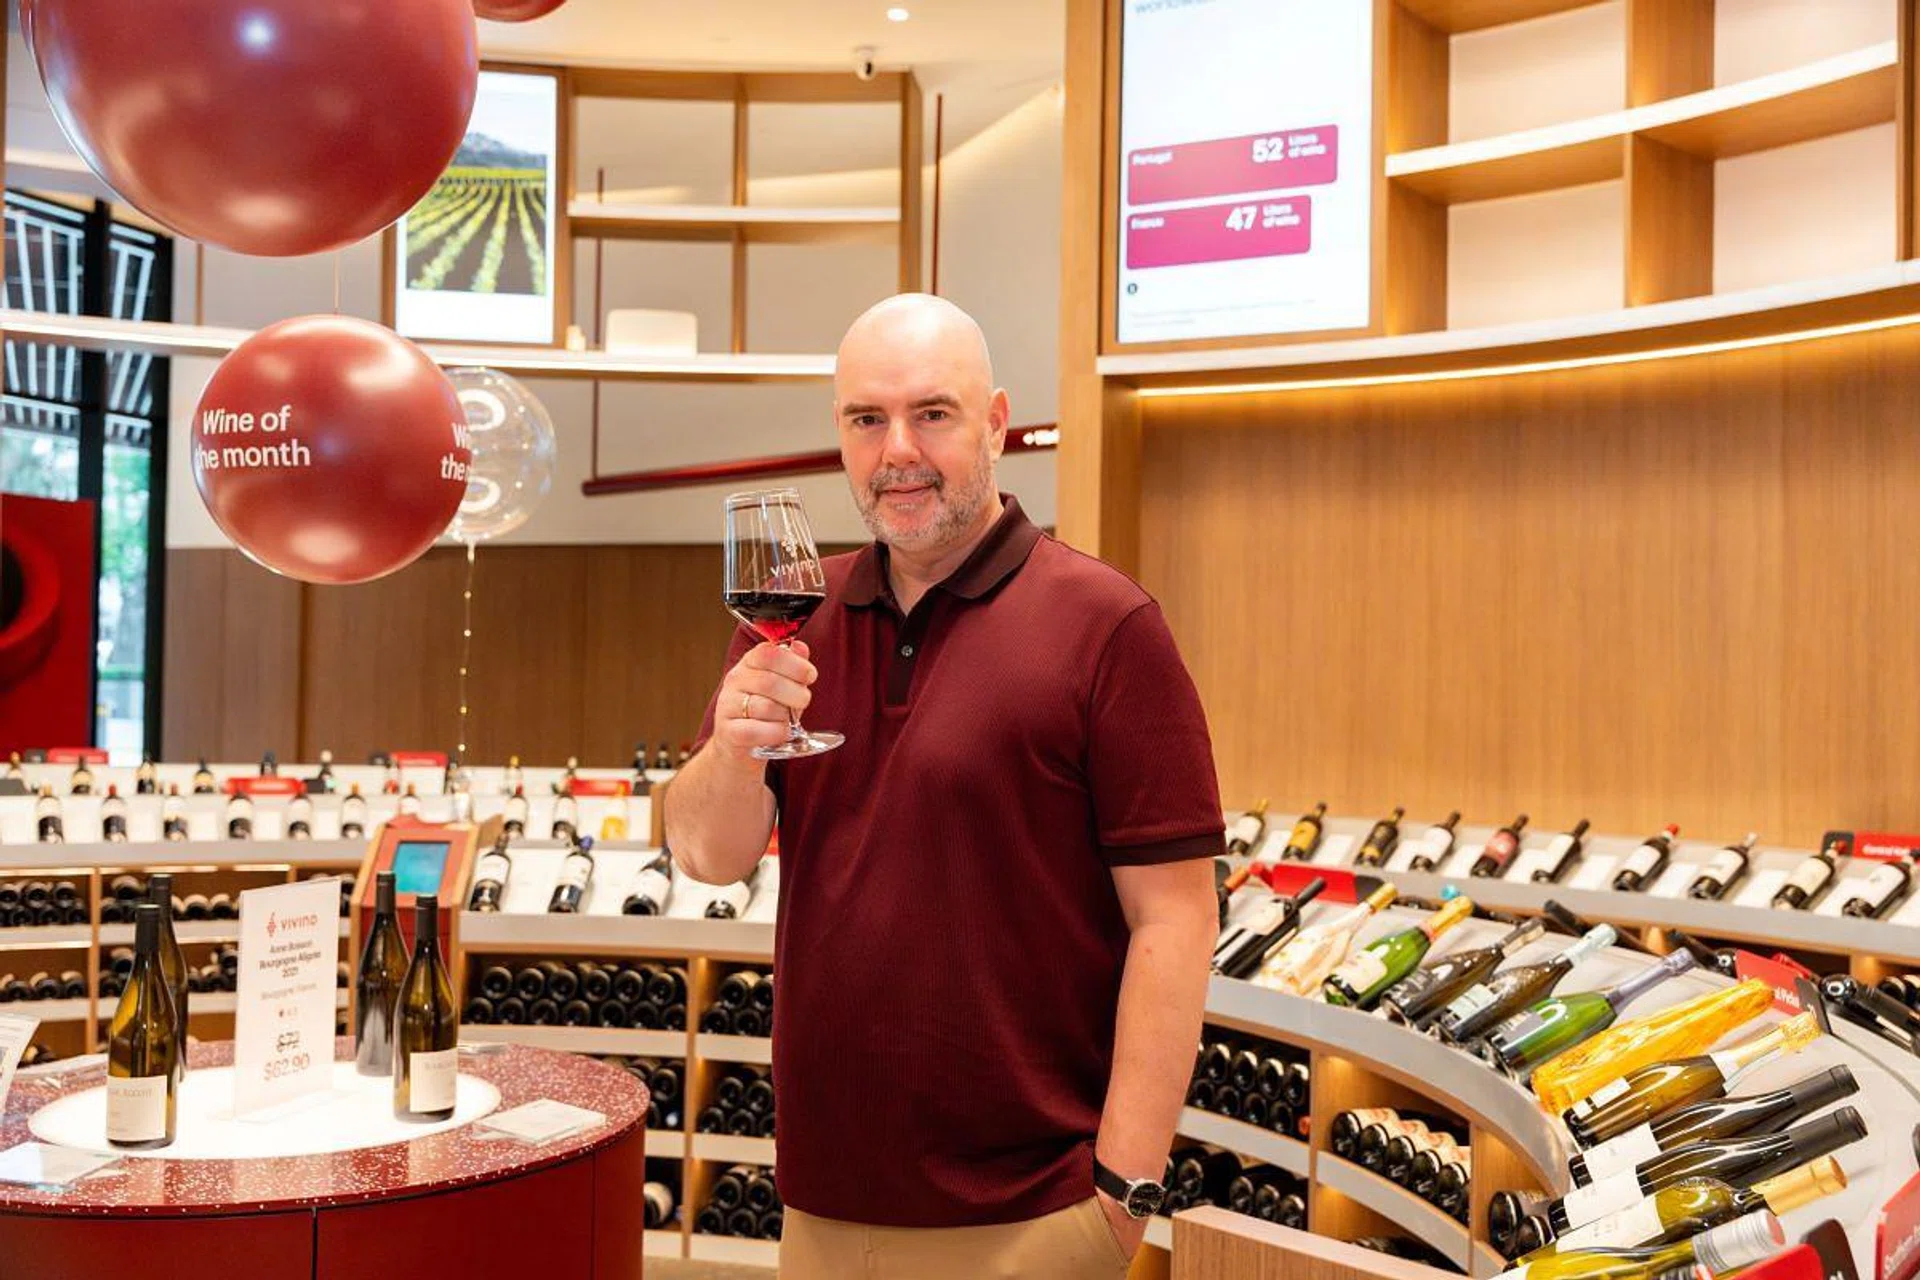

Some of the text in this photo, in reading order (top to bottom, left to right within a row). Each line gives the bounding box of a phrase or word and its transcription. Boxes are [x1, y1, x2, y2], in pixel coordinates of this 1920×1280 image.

[1253, 137, 1284, 163] 52
[1226, 206, 1257, 231] 47
[203, 404, 291, 435] Wine of
[222, 438, 311, 468] month
[441, 452, 465, 482] the
[263, 1053, 310, 1081] $62.90
